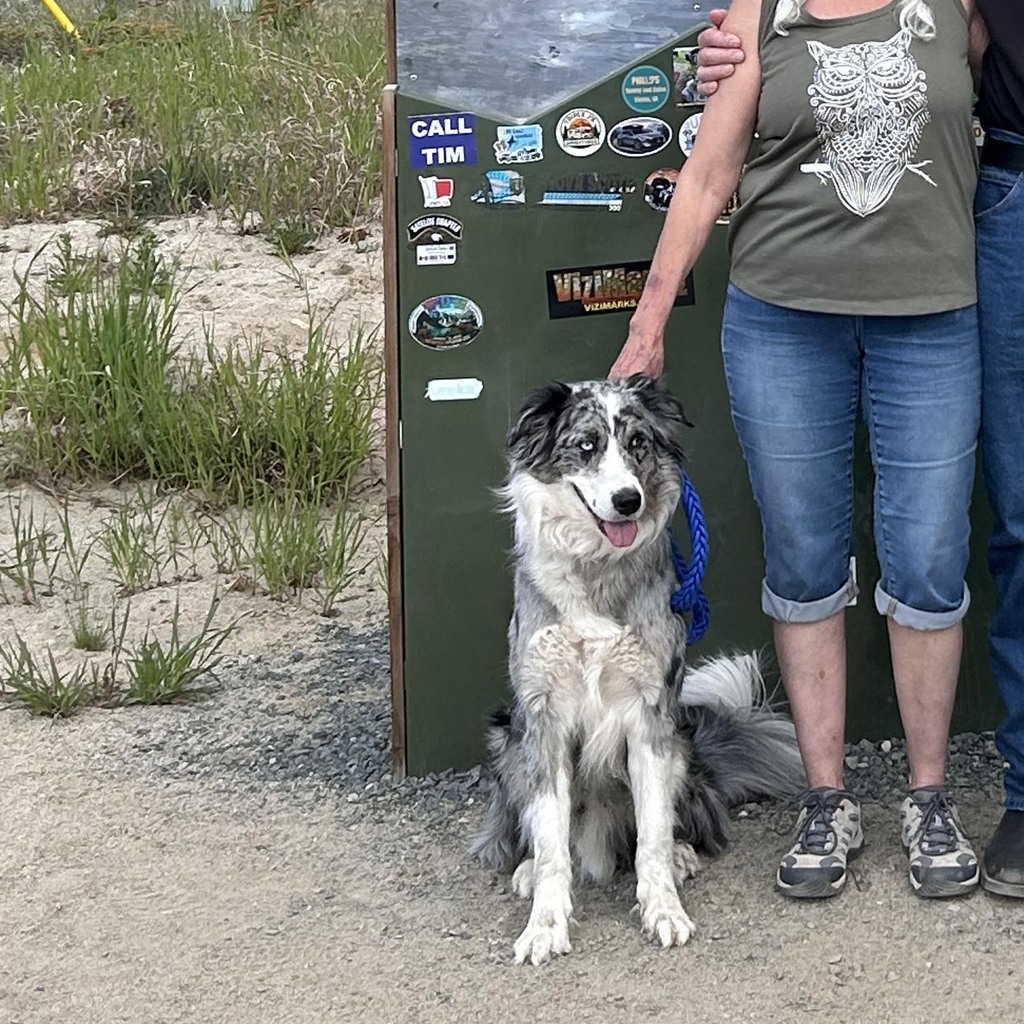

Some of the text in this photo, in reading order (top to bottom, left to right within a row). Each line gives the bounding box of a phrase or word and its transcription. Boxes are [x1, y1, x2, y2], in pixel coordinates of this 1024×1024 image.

[411, 117, 473, 138] CALL
[421, 146, 465, 165] TIM
[584, 300, 640, 312] VIZIMARKS.
